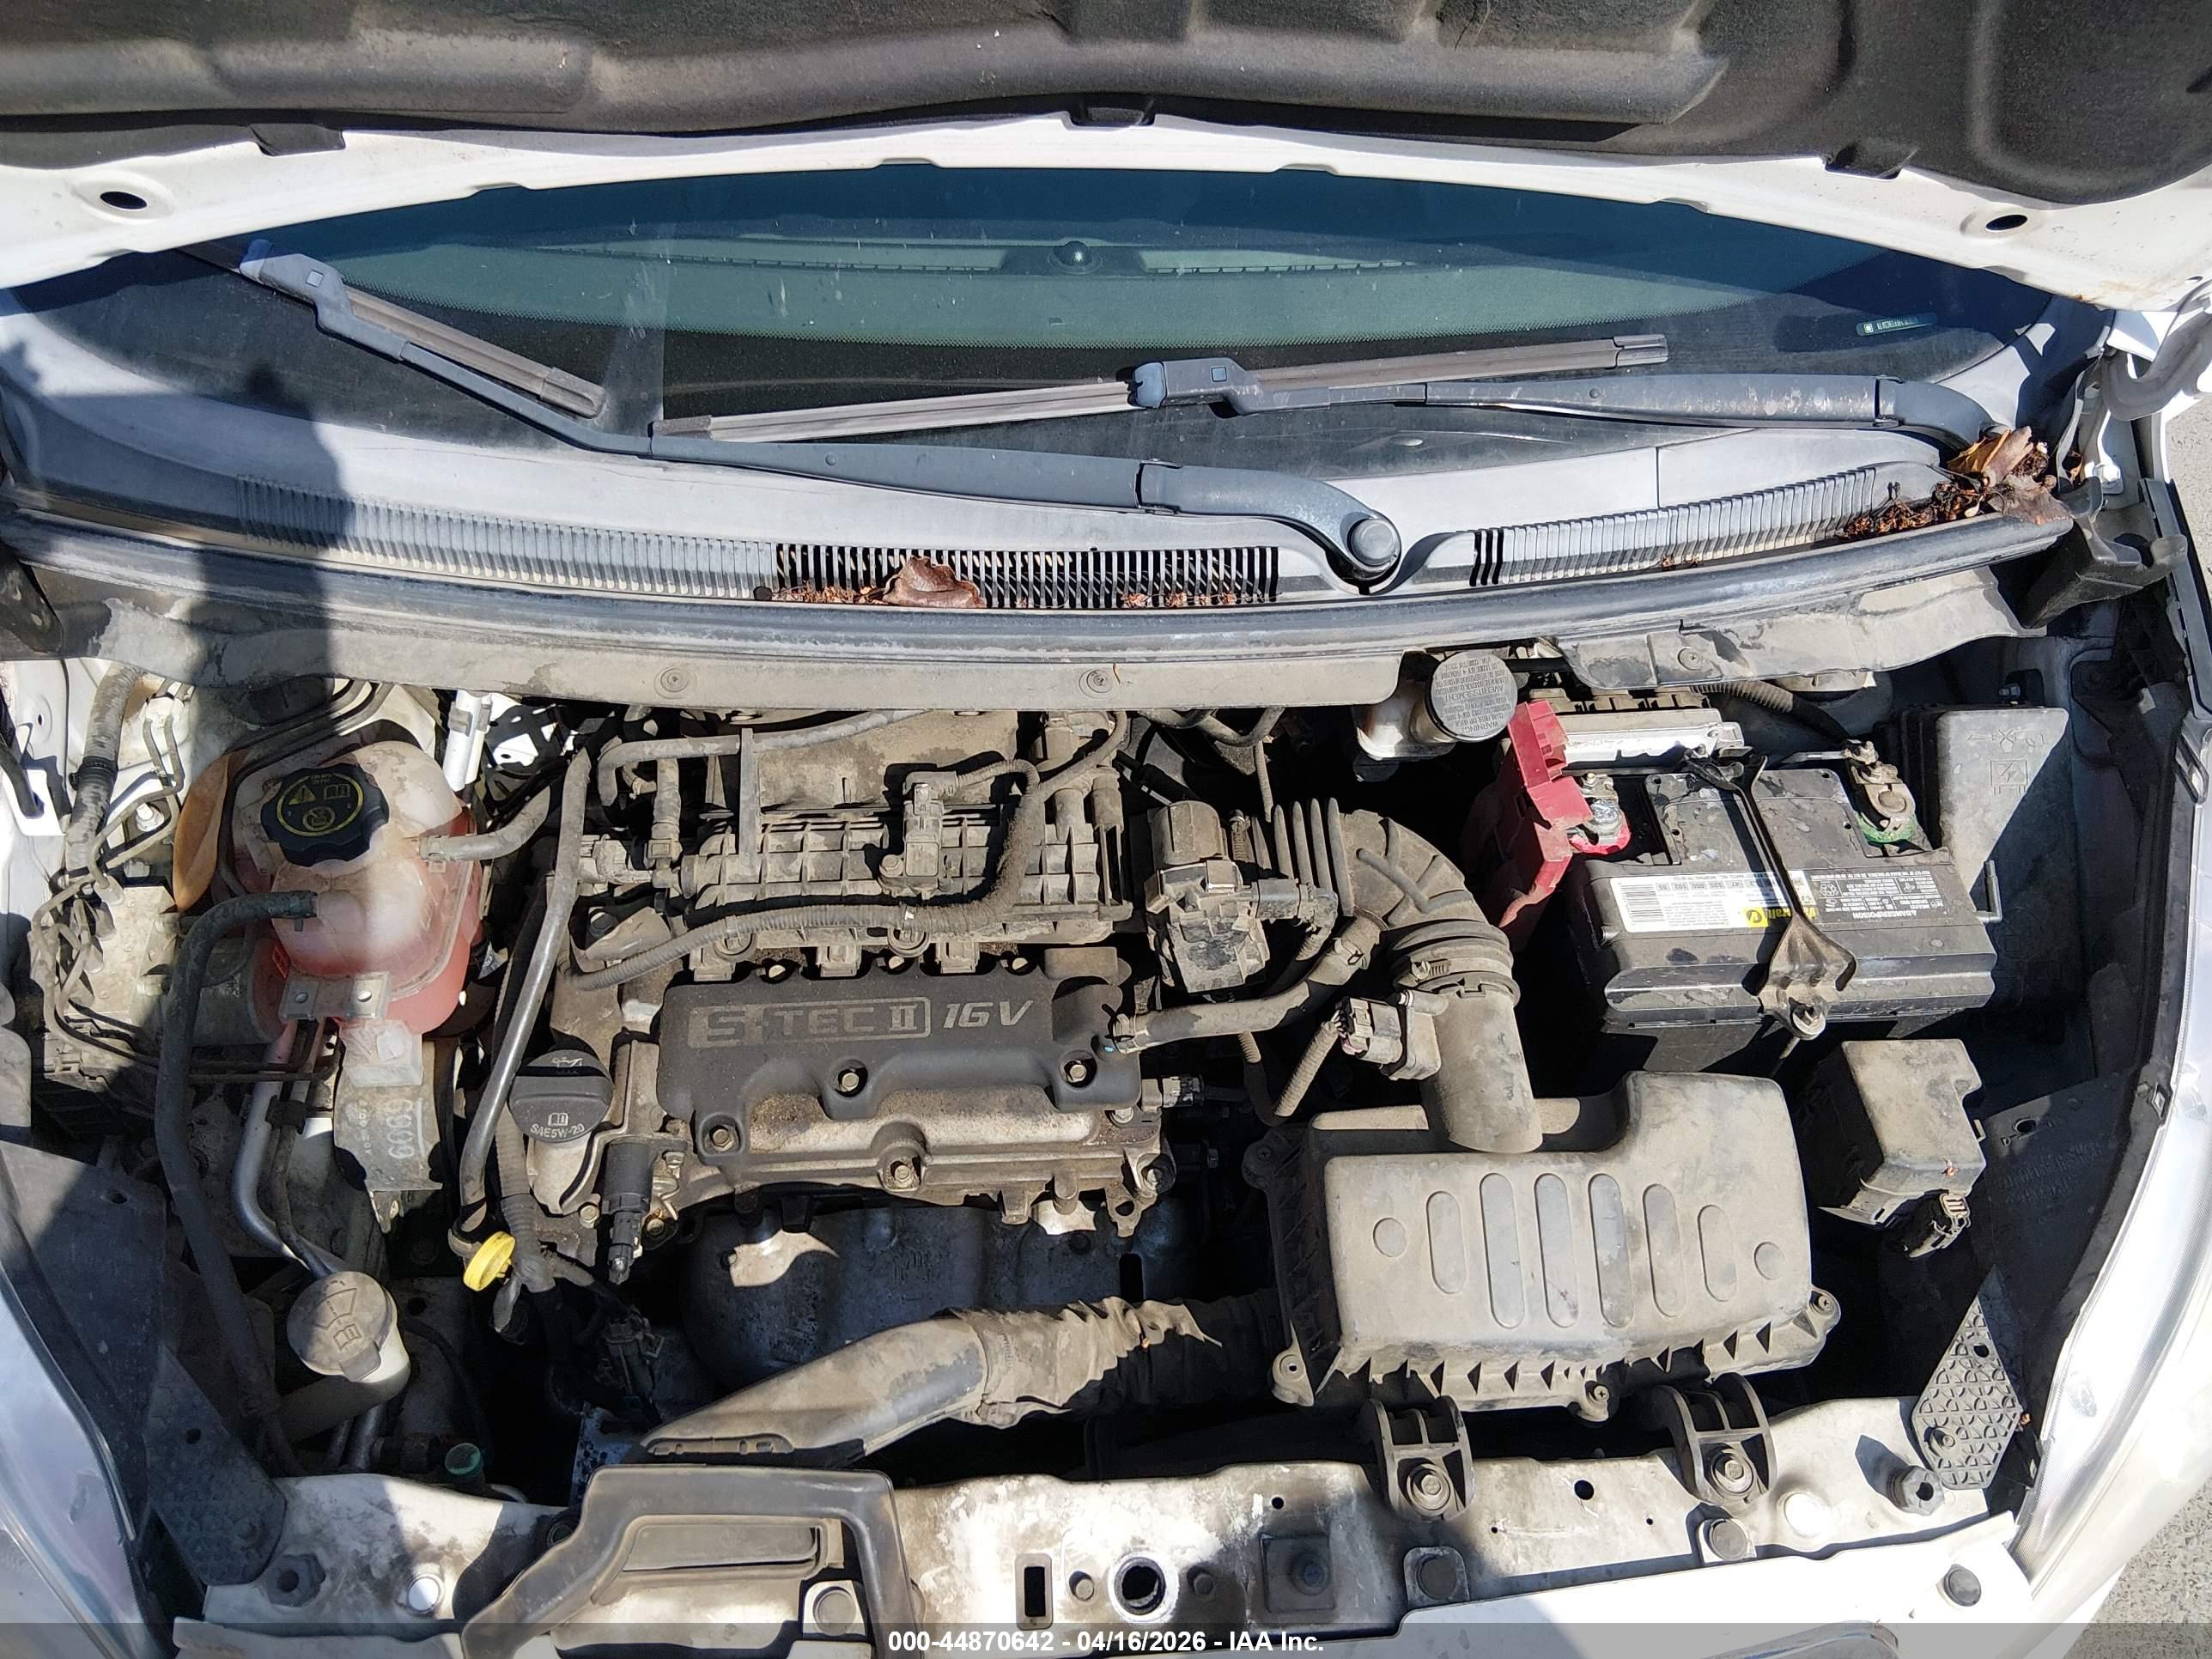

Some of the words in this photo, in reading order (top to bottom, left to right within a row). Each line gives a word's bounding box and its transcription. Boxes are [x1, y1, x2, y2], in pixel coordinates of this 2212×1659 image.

[1445, 685, 1503, 701] AVERTISSEMENT
[943, 1000, 1033, 1029] 16V
[530, 1123, 585, 1139] SAE5W-20
